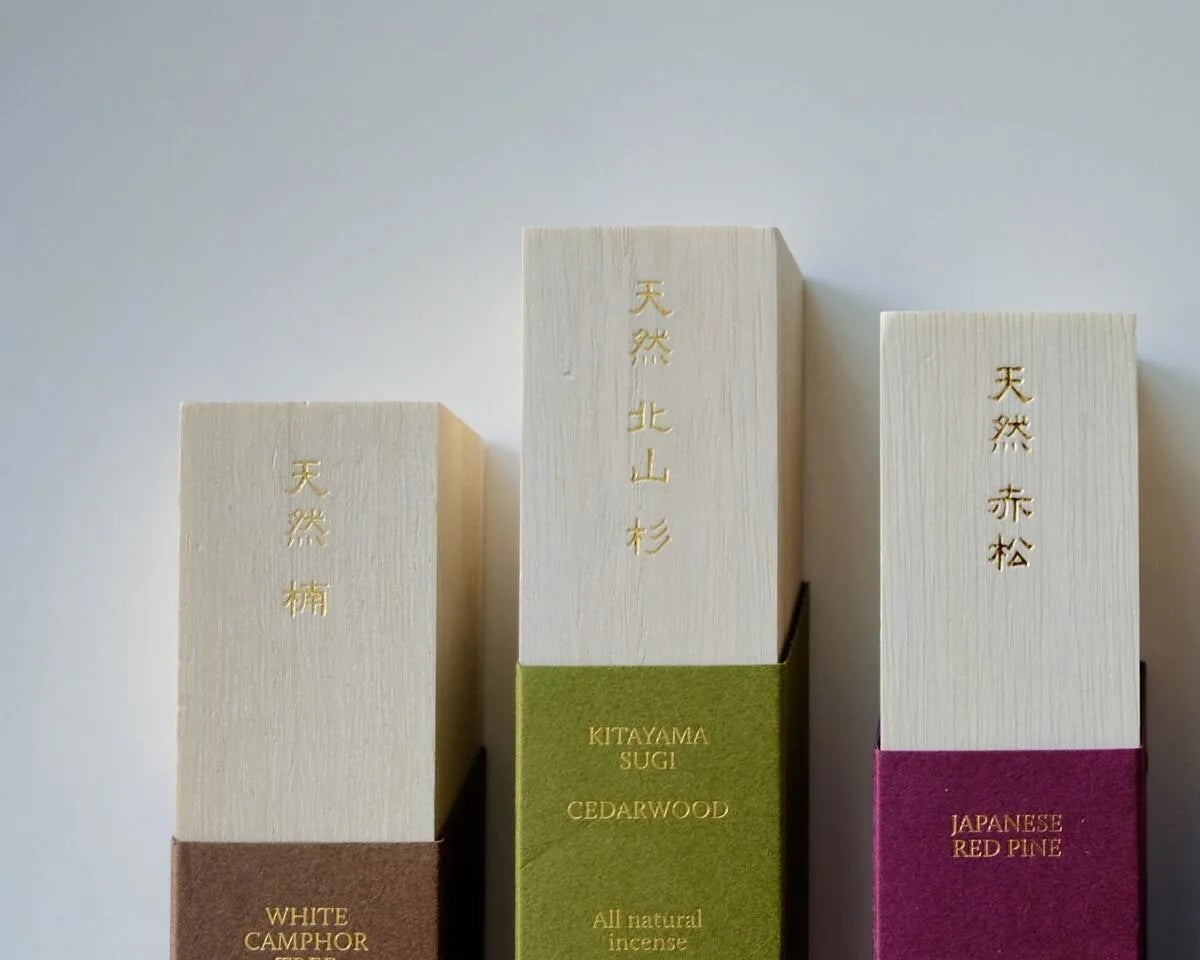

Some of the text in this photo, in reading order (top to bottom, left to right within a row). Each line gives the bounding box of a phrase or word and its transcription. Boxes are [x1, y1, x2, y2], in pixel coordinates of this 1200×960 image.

[629, 278, 673, 366] 天然
[987, 365, 1034, 571] 天然 赤松
[283, 459, 331, 619] 天然 楠
[588, 726, 710, 746] KITAYAMA
[619, 751, 676, 770] SUGI
[567, 801, 729, 820] CEDARWOOD
[950, 814, 1063, 837] JAPANESE
[953, 838, 1062, 858] RED PINE
[265, 907, 348, 926] WHITE
[593, 908, 703, 929] All natural
[244, 932, 369, 951] CAMPHOR
[608, 933, 688, 951] incense
